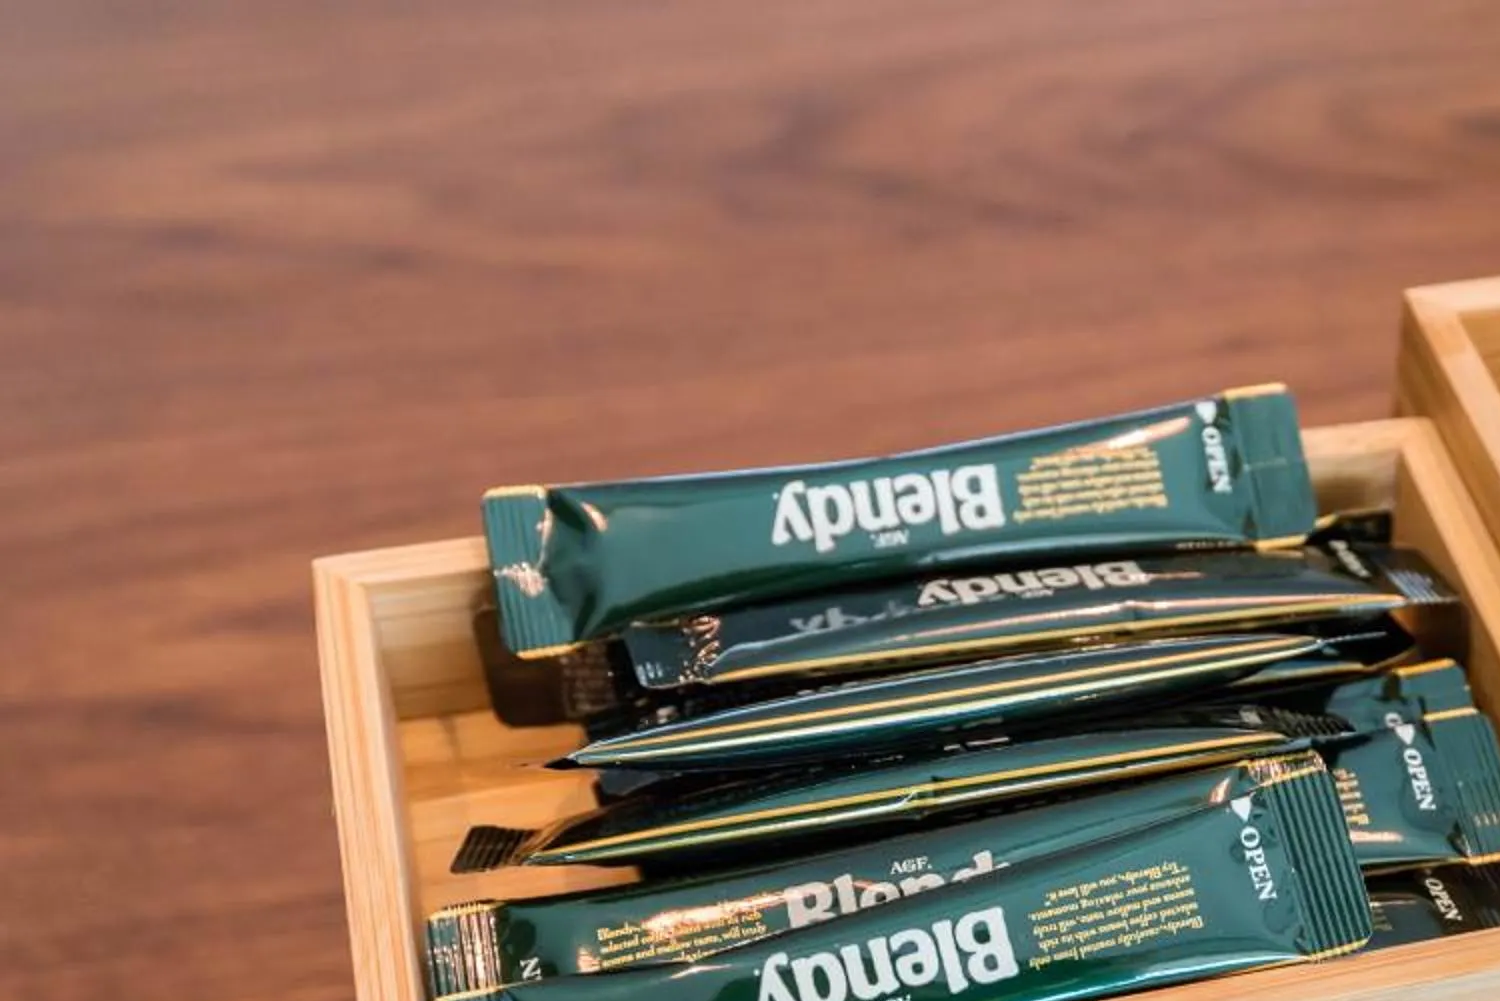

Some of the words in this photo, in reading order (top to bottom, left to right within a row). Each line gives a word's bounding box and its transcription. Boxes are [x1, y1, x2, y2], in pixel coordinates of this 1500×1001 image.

[1201, 427, 1232, 493] OPEN
[771, 463, 1006, 552] Blendy
[918, 561, 1148, 607] Blendy
[1404, 748, 1437, 810] OPEN
[1241, 828, 1278, 901] OPEN
[1425, 877, 1463, 921] OPEN
